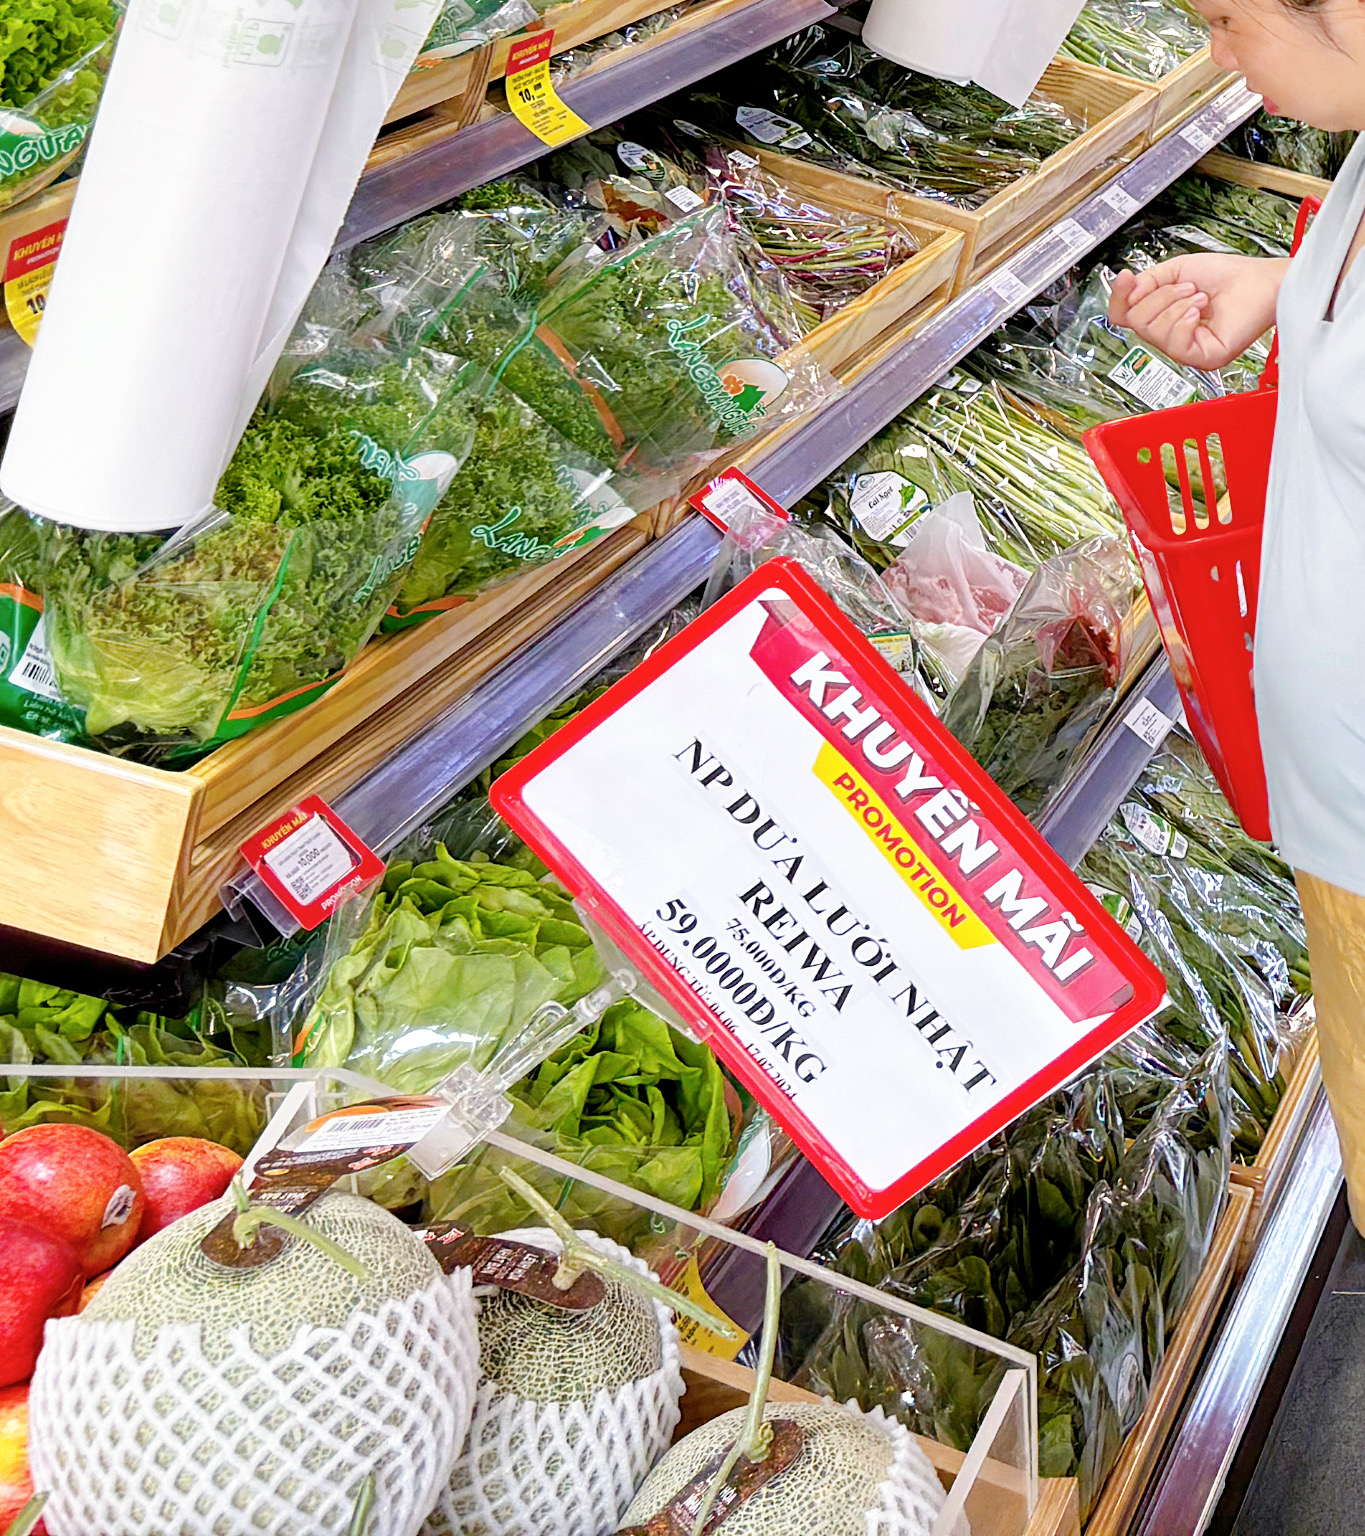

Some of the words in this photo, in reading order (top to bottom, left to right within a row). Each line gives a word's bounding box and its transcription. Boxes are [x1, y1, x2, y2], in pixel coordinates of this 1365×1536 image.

[14, 234, 56, 261] KHUYẾN
[791, 650, 1000, 879] KHUYẾN
[984, 868, 1094, 984] MÃI
[832, 771, 968, 932] PROMOTION
[654, 896, 829, 1089] 59.0000Đ/KG
[672, 735, 735, 812] NP
[722, 783, 807, 884] DƯA
[800, 868, 900, 986] LƯỚI
[891, 979, 1000, 1096] NHẬT
[736, 877, 852, 1015] REIWA
